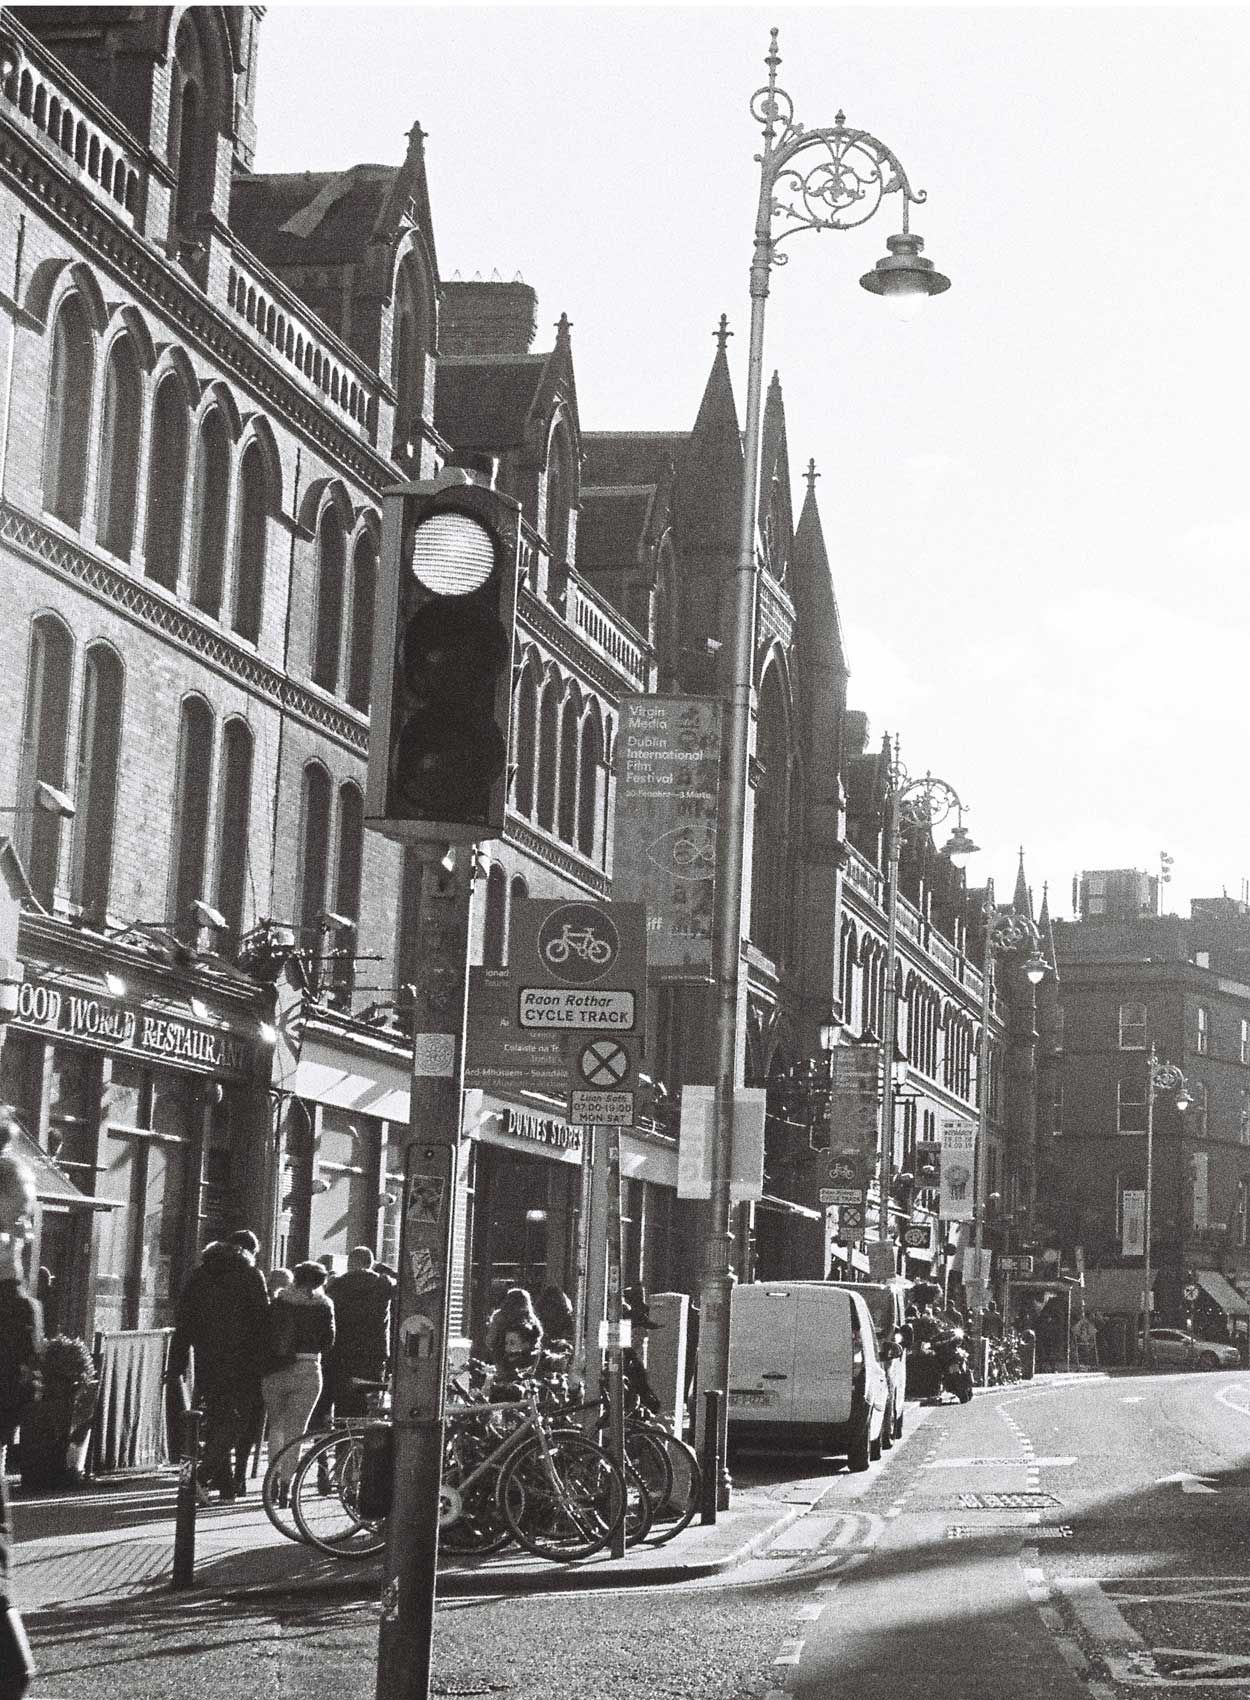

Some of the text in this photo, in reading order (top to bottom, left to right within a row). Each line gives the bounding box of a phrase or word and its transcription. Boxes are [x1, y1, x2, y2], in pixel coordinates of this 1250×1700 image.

[629, 704, 665, 719] Virgin
[628, 718, 667, 729] Media
[628, 735, 667, 748] Dublin
[627, 748, 703, 761] International
[626, 760, 652, 772] Film
[626, 772, 673, 784] Festival
[525, 993, 612, 1008] Raon Rothar
[525, 1009, 629, 1023] CYCLE TRACK
[13, 982, 246, 1069] OOD WORLD RESTAURAN
[508, 1108, 583, 1152] DUNNES STORES
